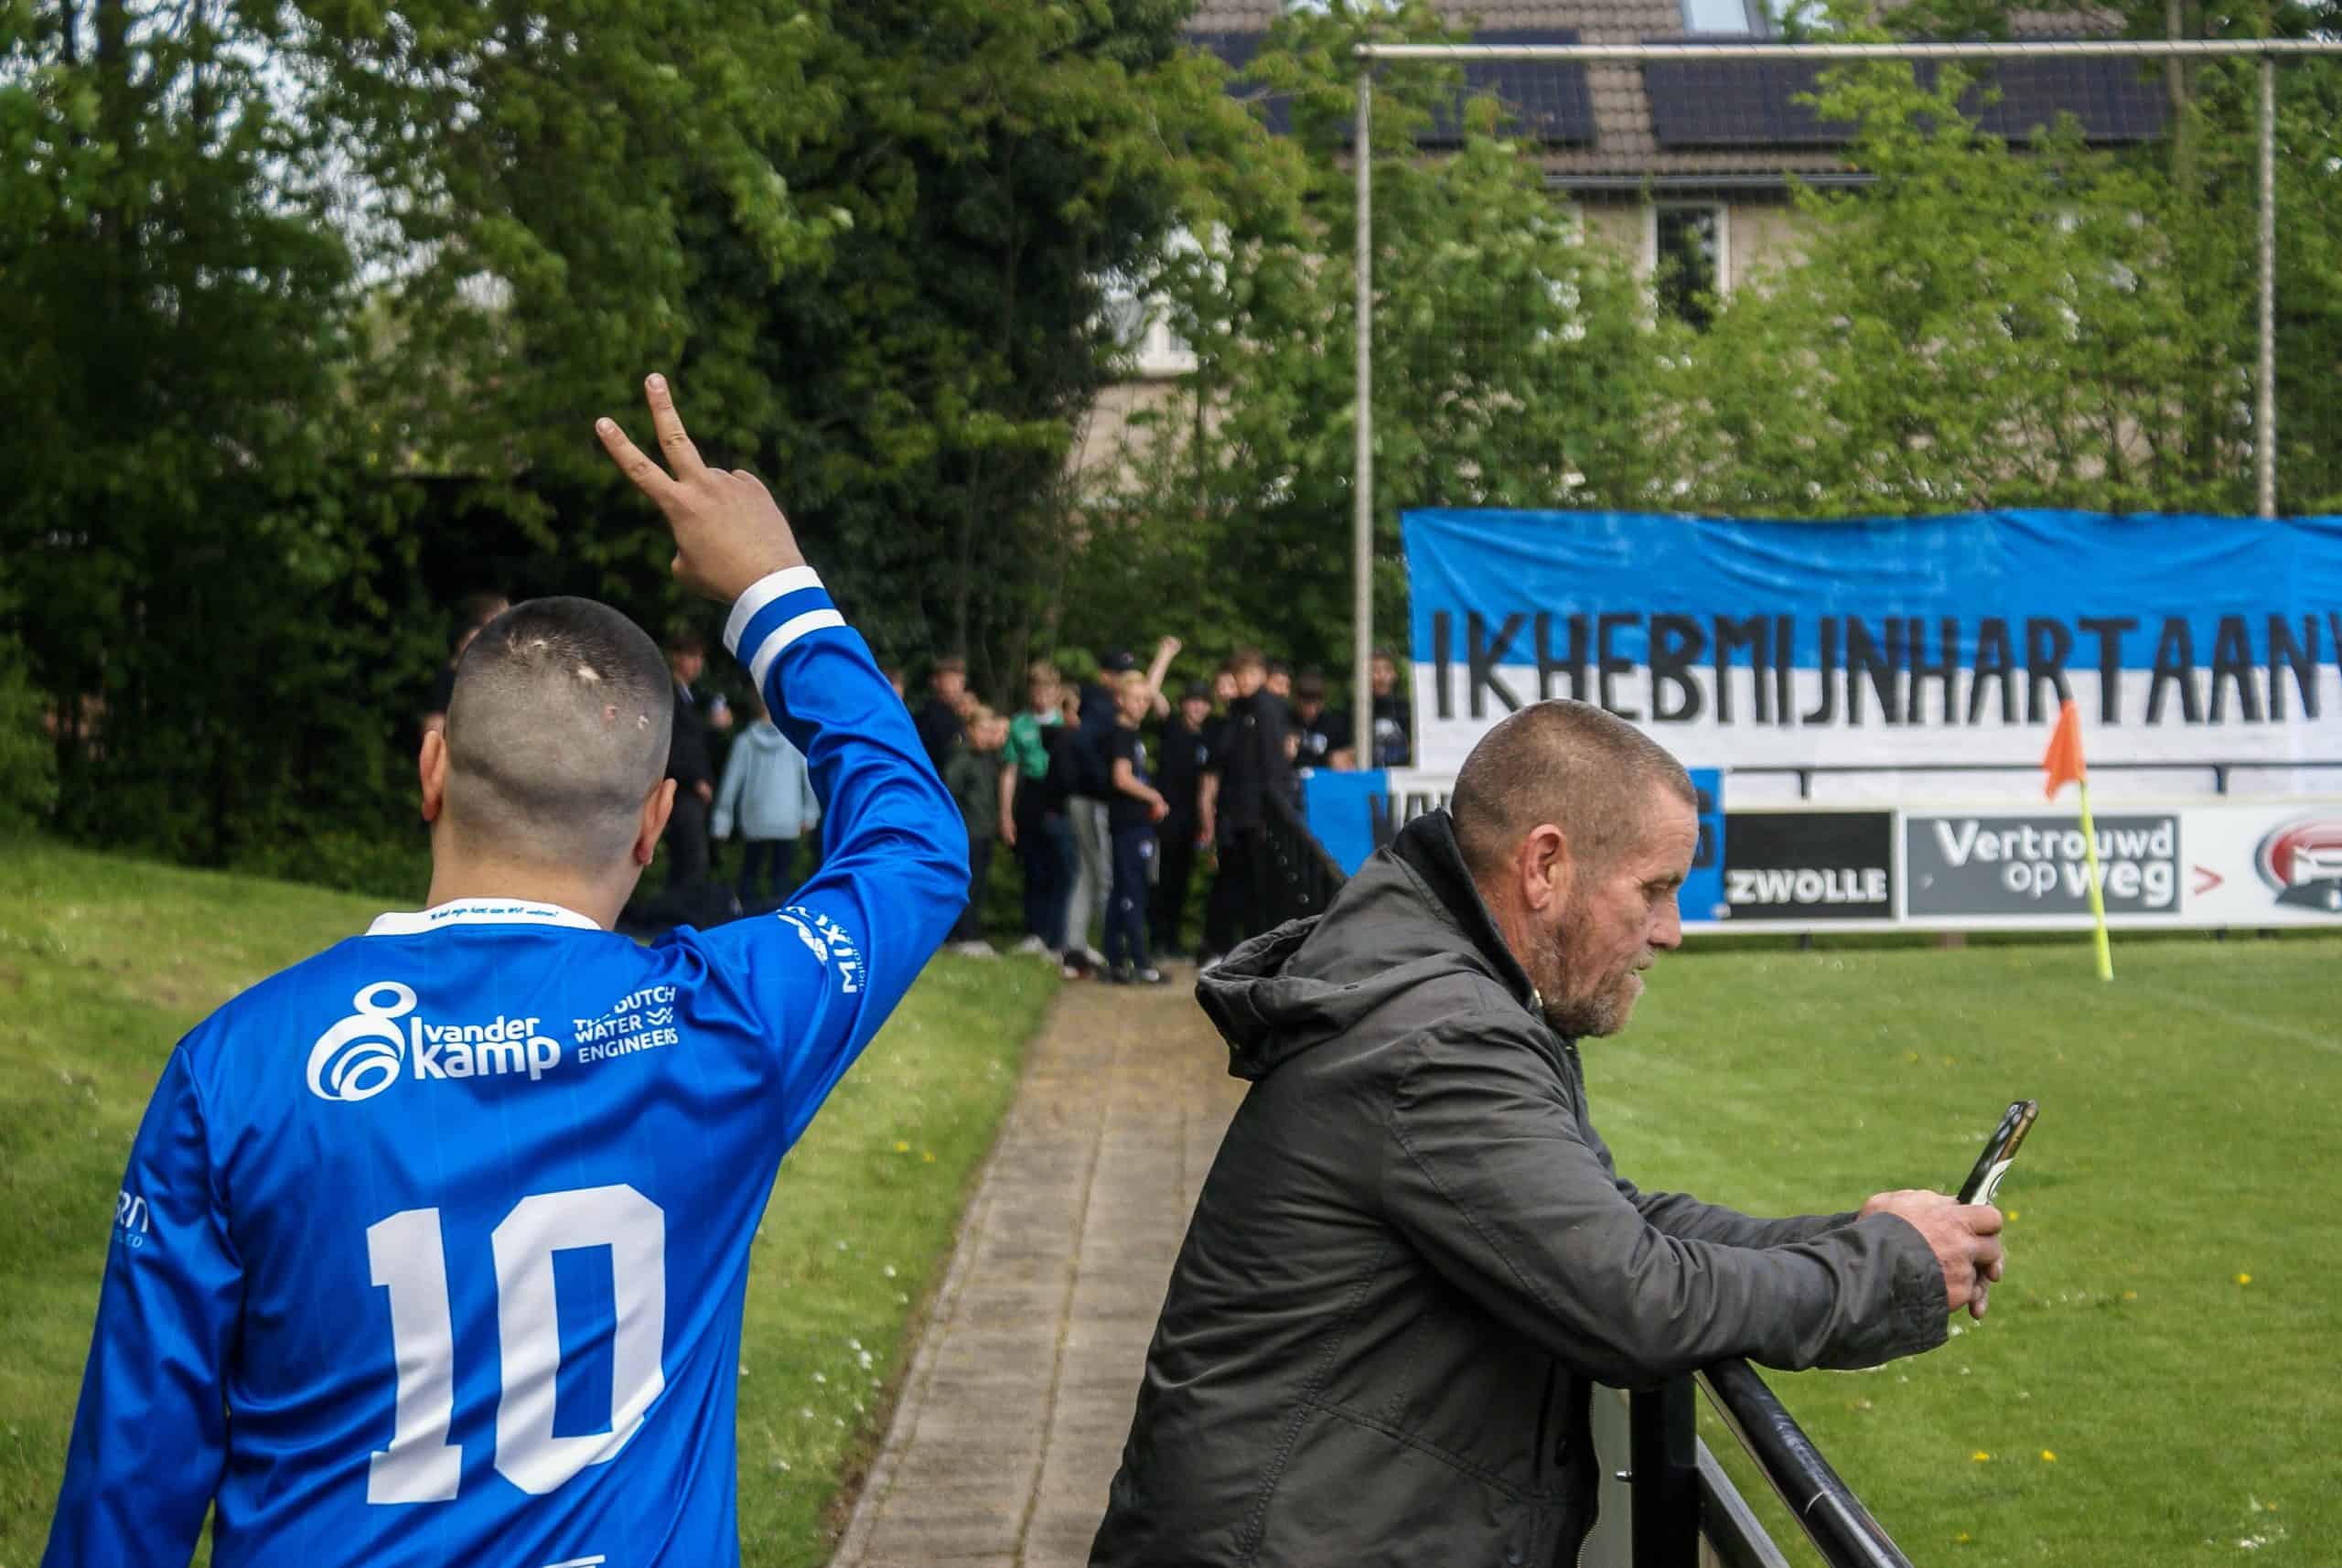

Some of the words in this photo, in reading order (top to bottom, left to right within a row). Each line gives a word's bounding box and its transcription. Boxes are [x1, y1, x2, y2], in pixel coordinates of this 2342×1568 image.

[1934, 819, 2175, 867] Vertrouwd
[1726, 868, 1888, 904] ZWOLLE
[2004, 860, 2058, 899] op
[2062, 859, 2175, 908] weg
[614, 985, 677, 1014] DUTCH
[410, 1015, 562, 1081] kamp
[424, 1015, 541, 1043] vander
[574, 1014, 644, 1044] WATER
[577, 1026, 679, 1064] ENGINEERS
[366, 1184, 666, 1505] 10
